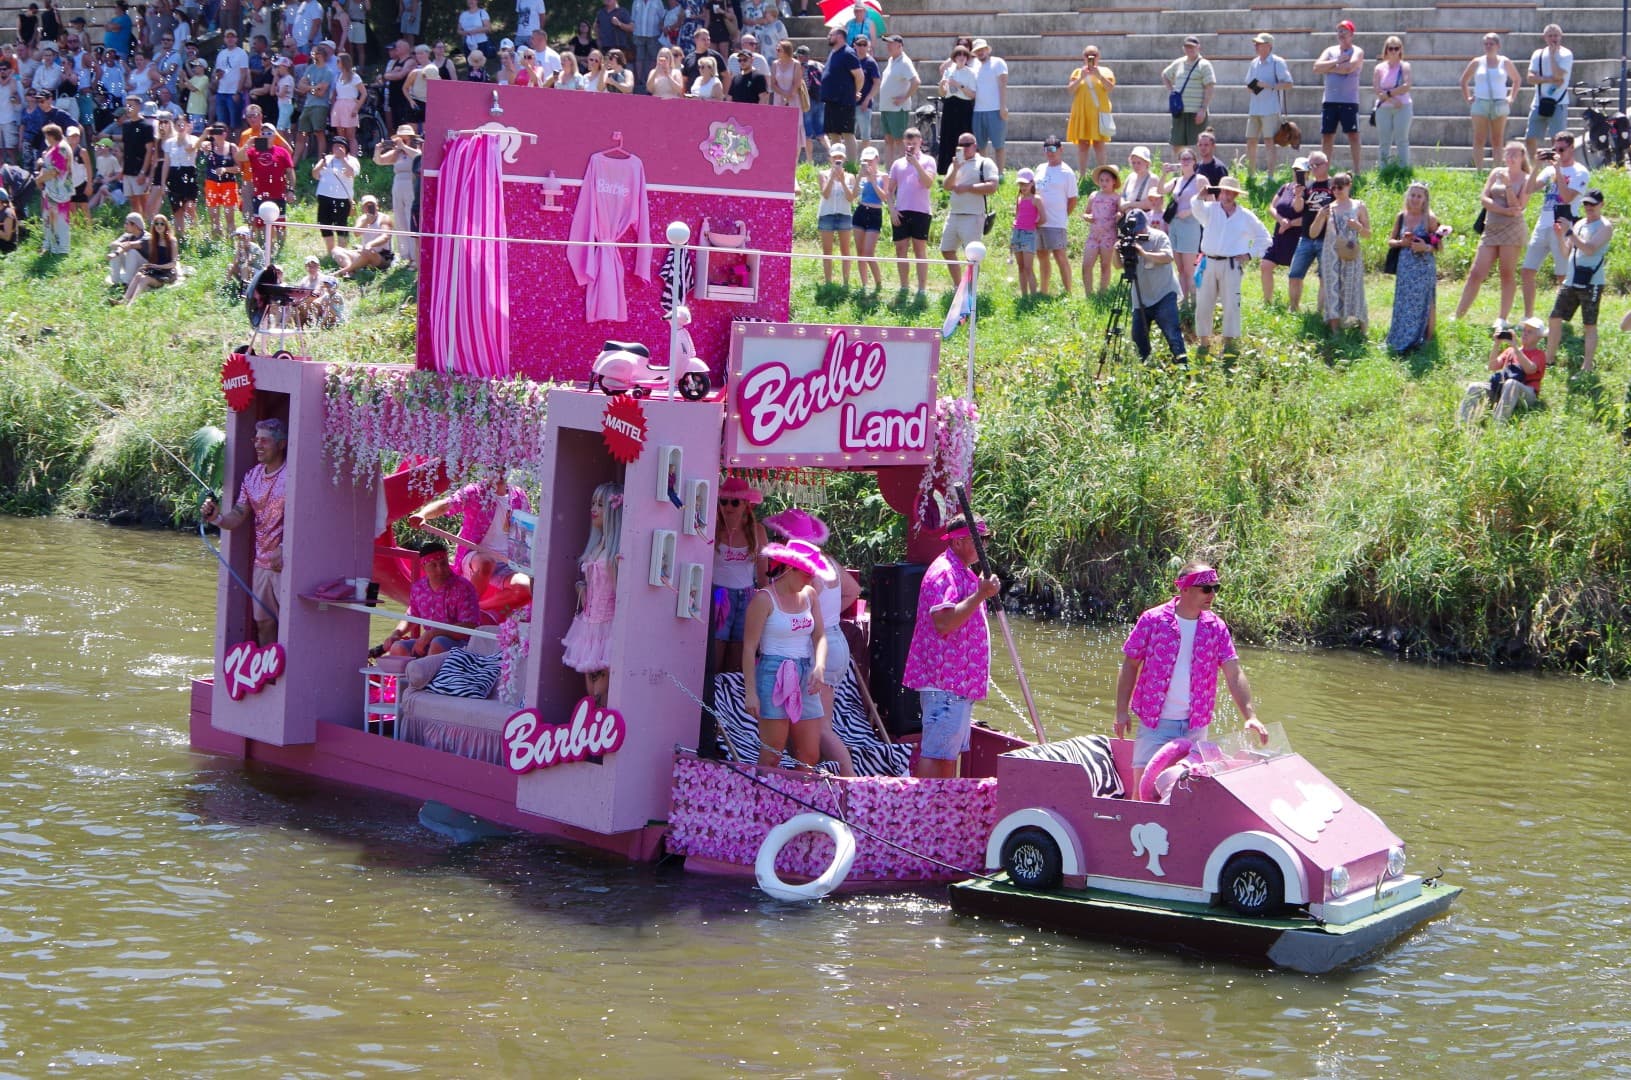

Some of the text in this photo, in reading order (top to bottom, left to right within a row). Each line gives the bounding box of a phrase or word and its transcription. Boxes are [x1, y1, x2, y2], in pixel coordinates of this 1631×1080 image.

[223, 375, 250, 391] MATTEL
[744, 333, 884, 442] Barbie
[605, 414, 642, 442] MATTEL
[845, 405, 927, 448] Land
[224, 644, 278, 698] Ken
[505, 700, 618, 771] Barbie
